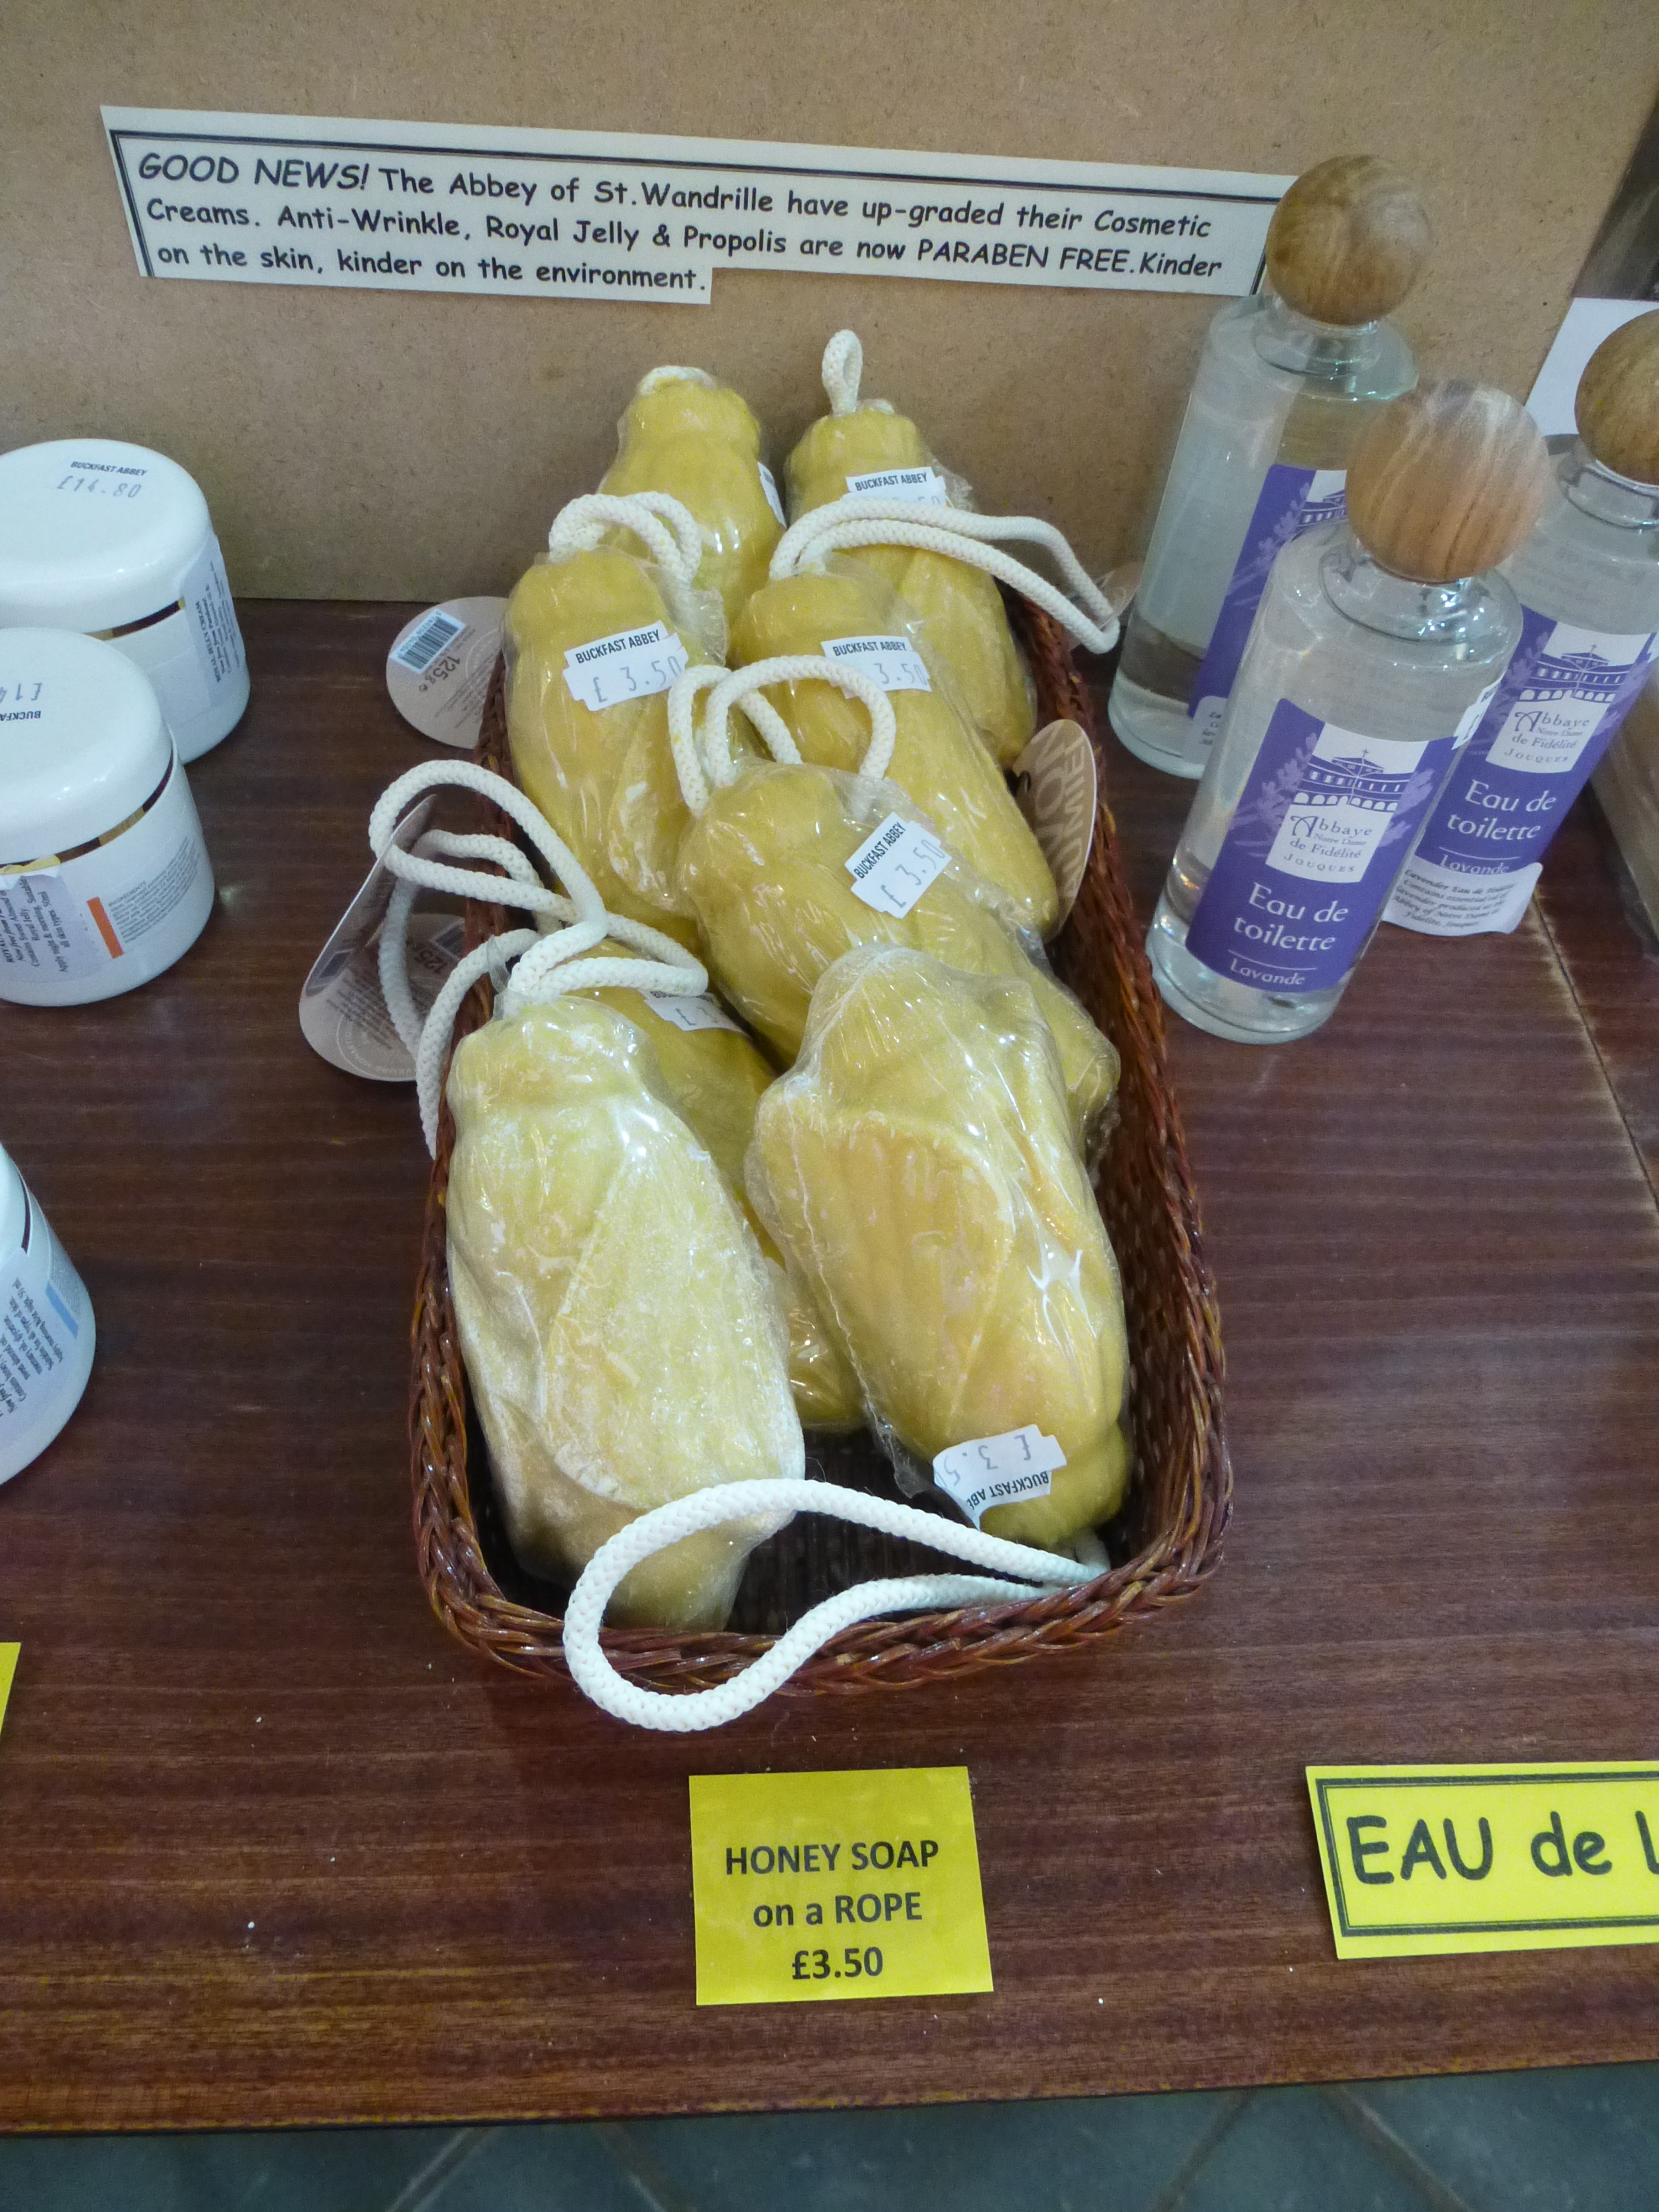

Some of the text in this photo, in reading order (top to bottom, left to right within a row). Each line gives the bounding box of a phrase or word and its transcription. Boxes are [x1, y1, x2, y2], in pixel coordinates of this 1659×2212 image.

[139, 153, 238, 183] GOOD
[254, 158, 369, 190] NEWS!
[379, 168, 434, 194] The
[449, 173, 536, 205] Abbey
[551, 177, 579, 202] of
[787, 190, 848, 217] have
[862, 200, 1005, 227] up-graded
[1016, 203, 1082, 230] their
[1094, 210, 1211, 238] Cosmetic
[147, 198, 260, 226] Creams.
[278, 205, 471, 241] Anti-Wrinkle,
[486, 216, 559, 246] Royal
[573, 220, 640, 252] Jelly
[653, 224, 670, 247] &
[684, 226, 786, 256] Propolis
[800, 237, 843, 256] are
[857, 238, 905, 260] now
[918, 238, 1048, 268] PARABEN
[158, 244, 705, 290] on the skin, kinder on the environment.
[70, 461, 148, 476] BUCKFAST ABBEY
[855, 472, 927, 491] BUCKFAST ABBEY
[576, 629, 660, 664] BUCKFAST ABBEY
[833, 641, 906, 656] BUCKFAST ABBEY
[1515, 711, 1589, 730] Abbaye
[1512, 733, 1528, 745] de
[1465, 779, 1557, 812] Eau de
[1290, 816, 1372, 838] Abbaye
[1448, 814, 1541, 840] toilette
[853, 821, 906, 879] BUCKFAST ABBEY
[1290, 838, 1362, 858] de Fidélité
[1440, 854, 1509, 875] Lavande
[1249, 881, 1349, 922] Eau de
[1234, 917, 1336, 951] toilette
[1230, 958, 1305, 985] Lavande
[989, 1470, 1050, 1498] BUCKFAST
[726, 1839, 939, 1875] HONEY SOAP
[1346, 1814, 1494, 1885] EAU
[1530, 1811, 1613, 1877] de
[753, 1892, 922, 1928] on a ROPE
[791, 1946, 884, 1981] £3.50
